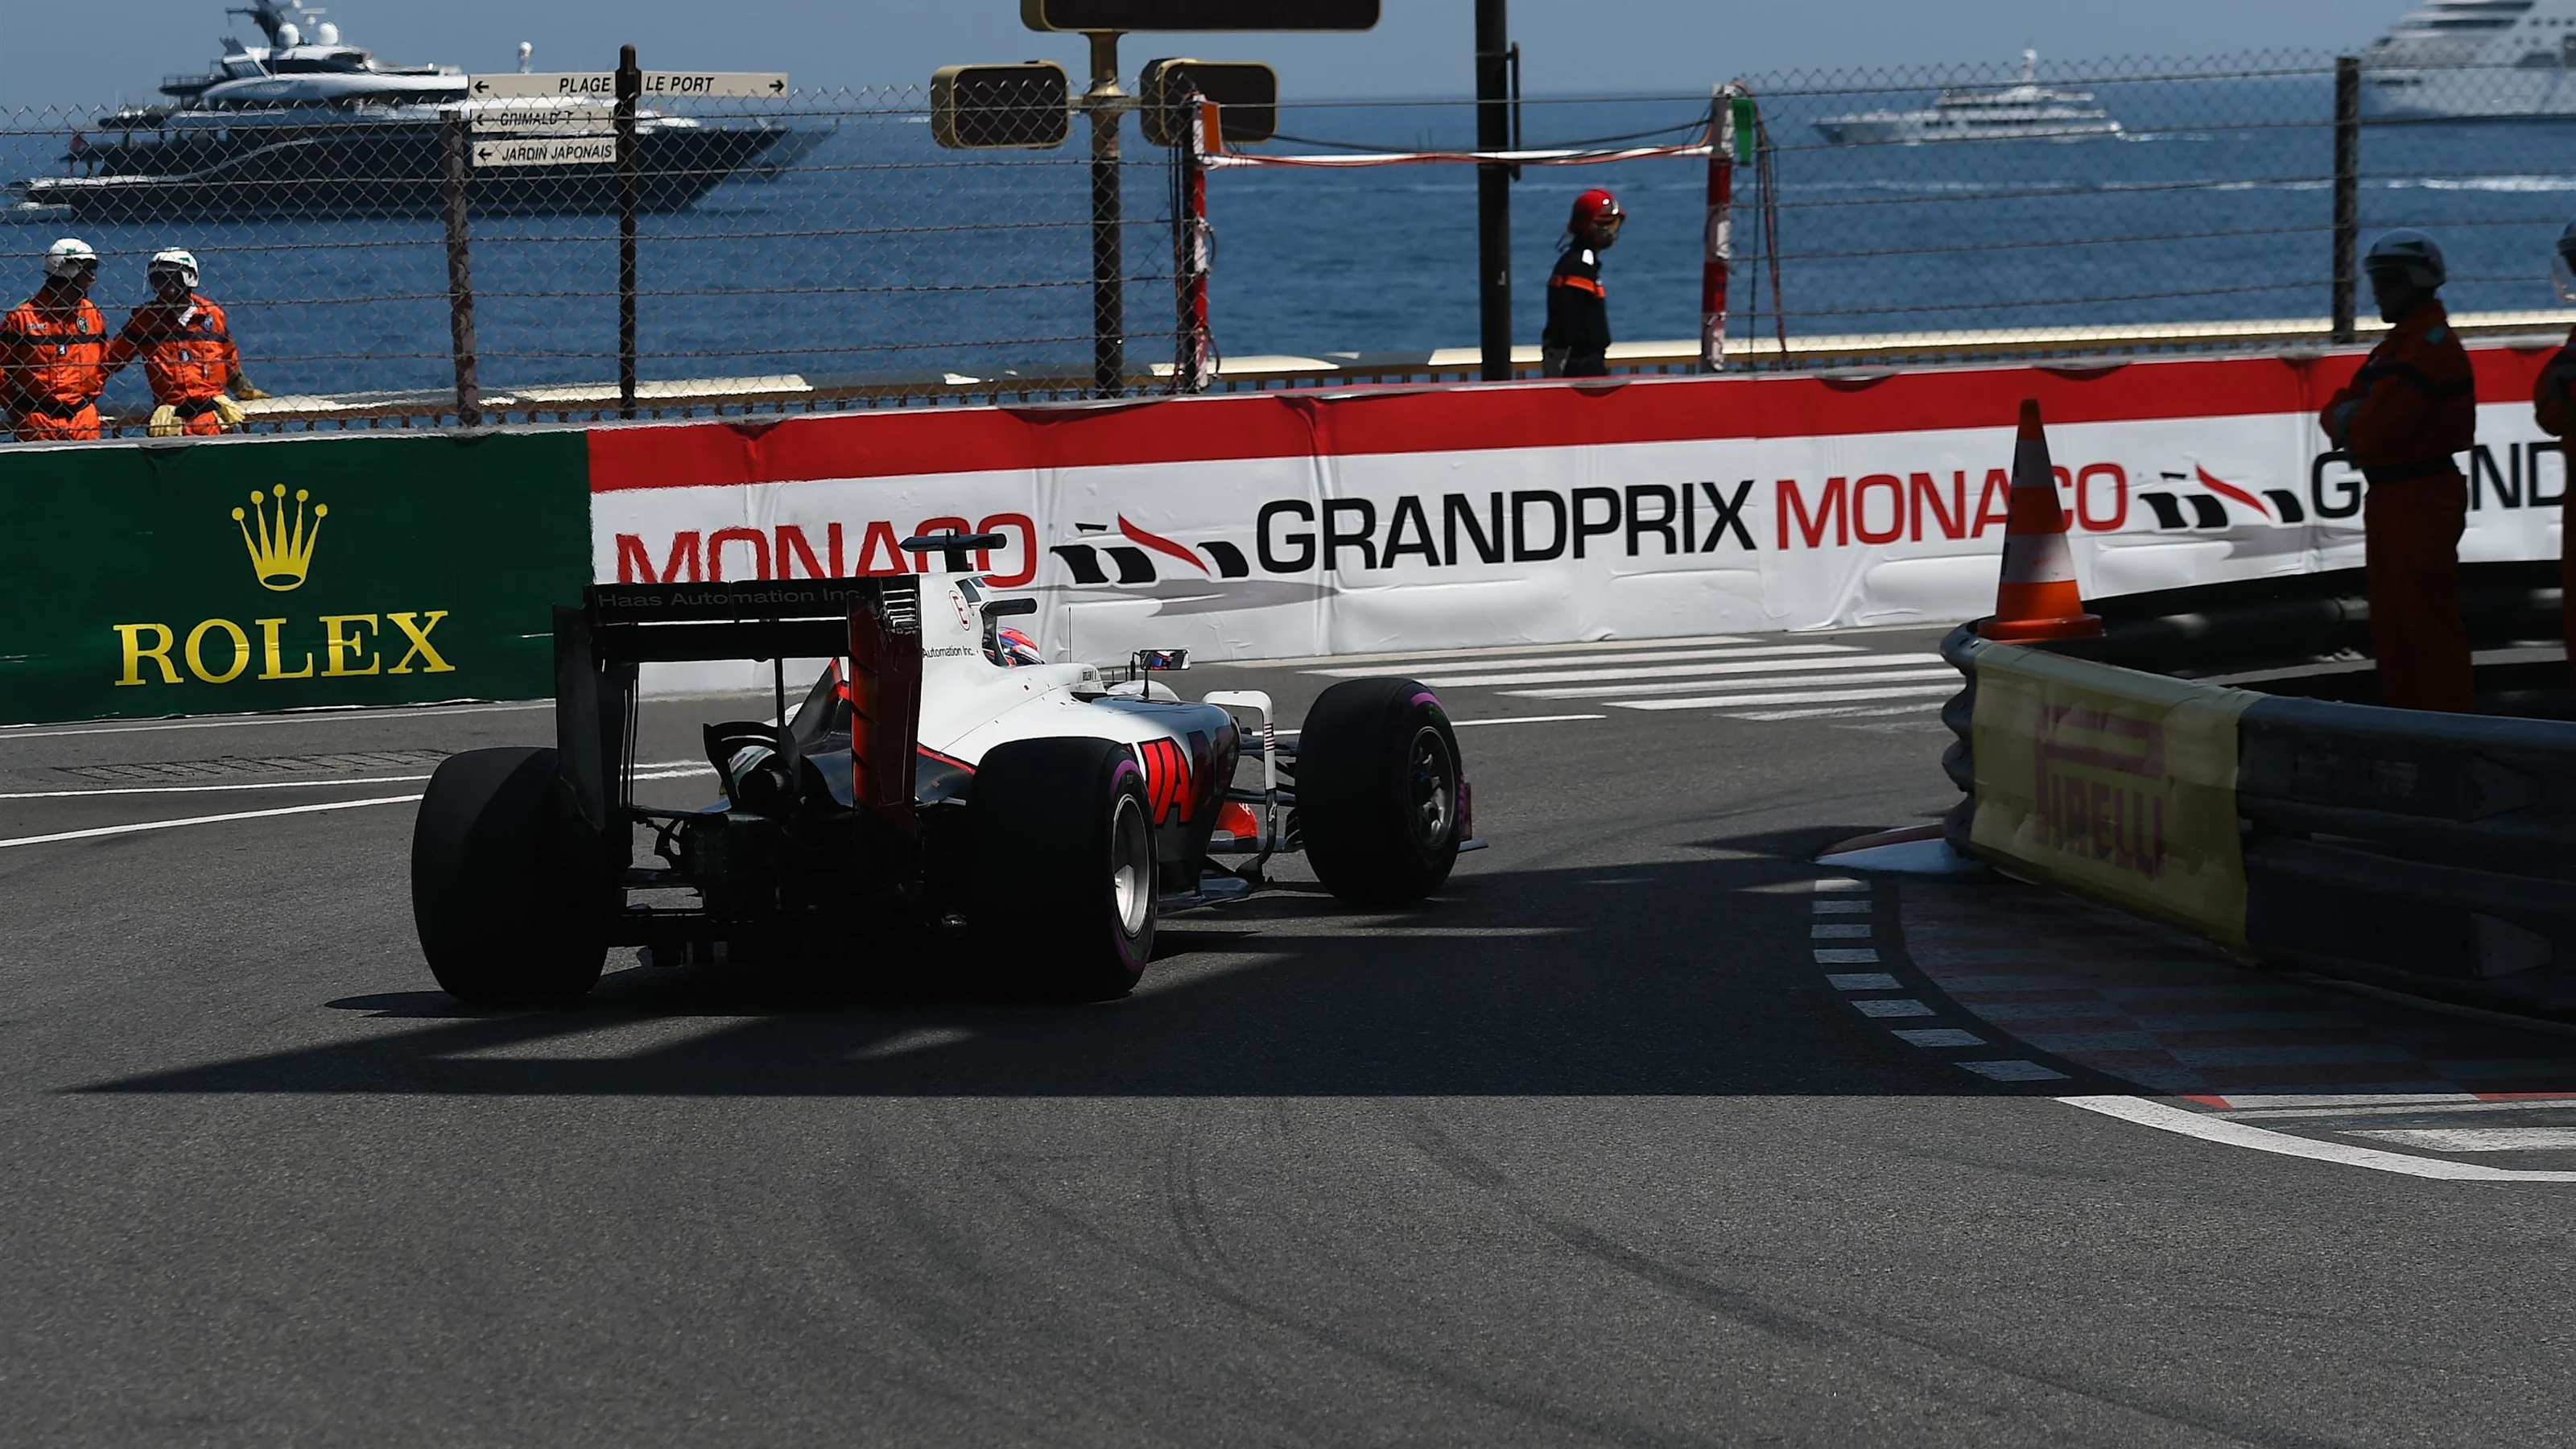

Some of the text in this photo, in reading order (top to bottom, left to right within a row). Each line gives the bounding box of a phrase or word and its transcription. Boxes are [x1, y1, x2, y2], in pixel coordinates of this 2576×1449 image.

[559, 77, 612, 93] PLAGE
[646, 76, 714, 92] LE PORT
[502, 144, 612, 162] JARDIN JAPONAIS
[1256, 479, 1757, 574] GRANDPRIX
[598, 588, 866, 608] Haas Automation Inc.
[113, 609, 456, 687] ROLEX
[923, 646, 976, 658] Automation Inc.
[2034, 703, 2164, 881] PIRELLI
